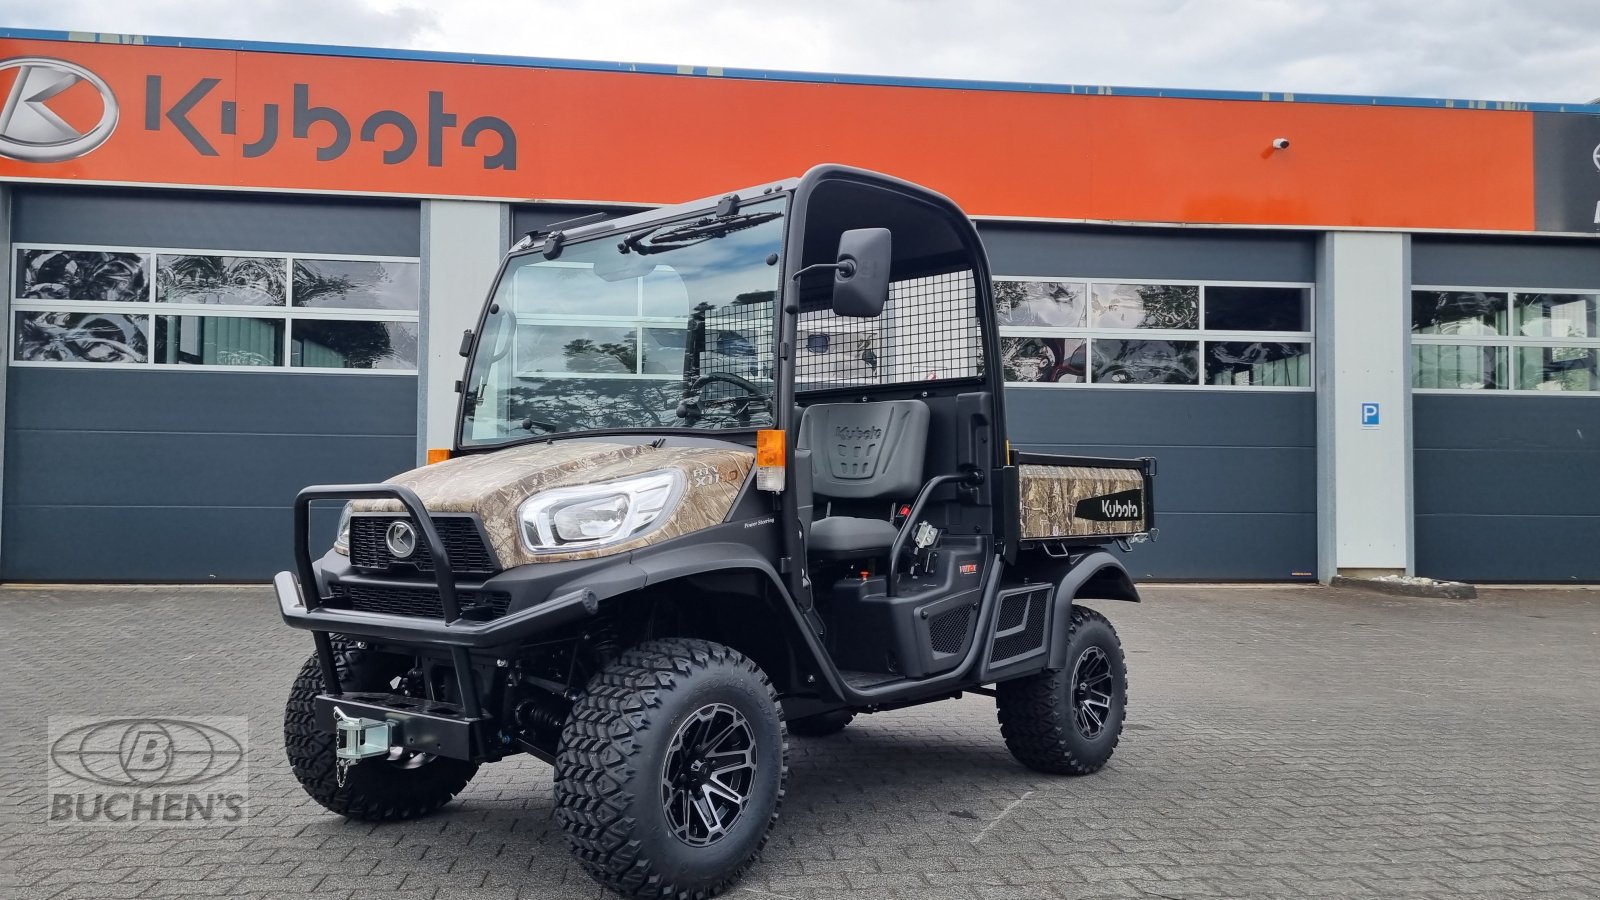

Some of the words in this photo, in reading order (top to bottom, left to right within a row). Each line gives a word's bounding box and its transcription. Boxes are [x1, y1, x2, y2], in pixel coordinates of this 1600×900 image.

[145, 74, 518, 171] Kubota
[1364, 405, 1377, 423] P
[835, 425, 882, 441] Kubota
[1101, 499, 1138, 518] Kubota
